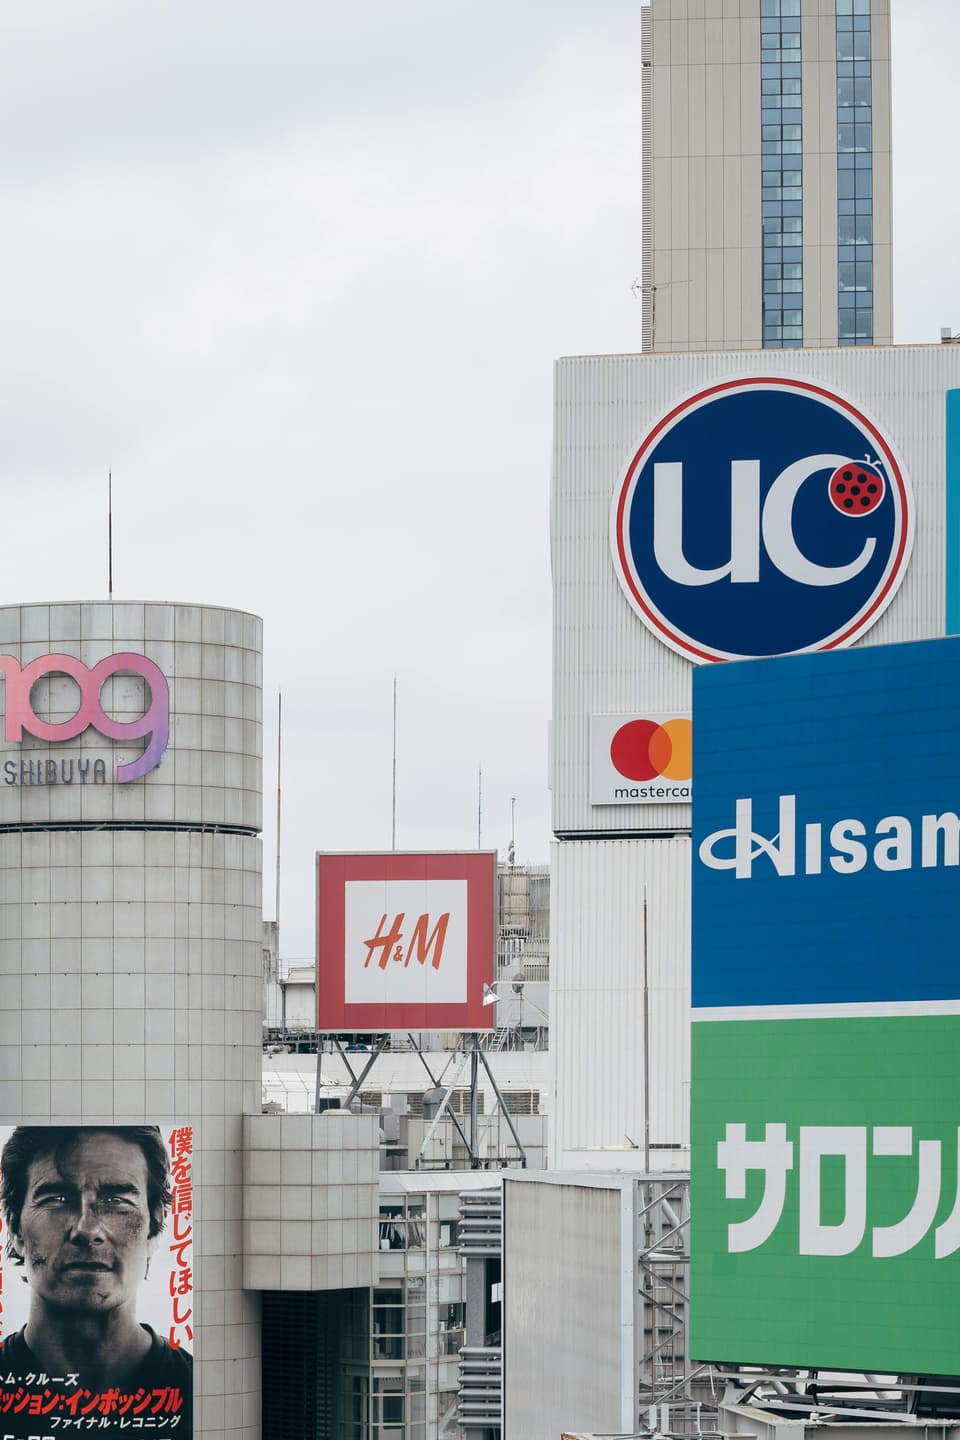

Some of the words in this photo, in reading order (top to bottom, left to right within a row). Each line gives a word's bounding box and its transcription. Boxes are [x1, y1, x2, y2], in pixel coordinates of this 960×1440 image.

[4, 758, 107, 785] SHIBUYA
[614, 785, 692, 799] masterca
[363, 912, 450, 970] H&M
[168, 1126, 194, 1350] 僕を信じてほしい
[50, 1415, 181, 1429] ファイナル・レコニング
